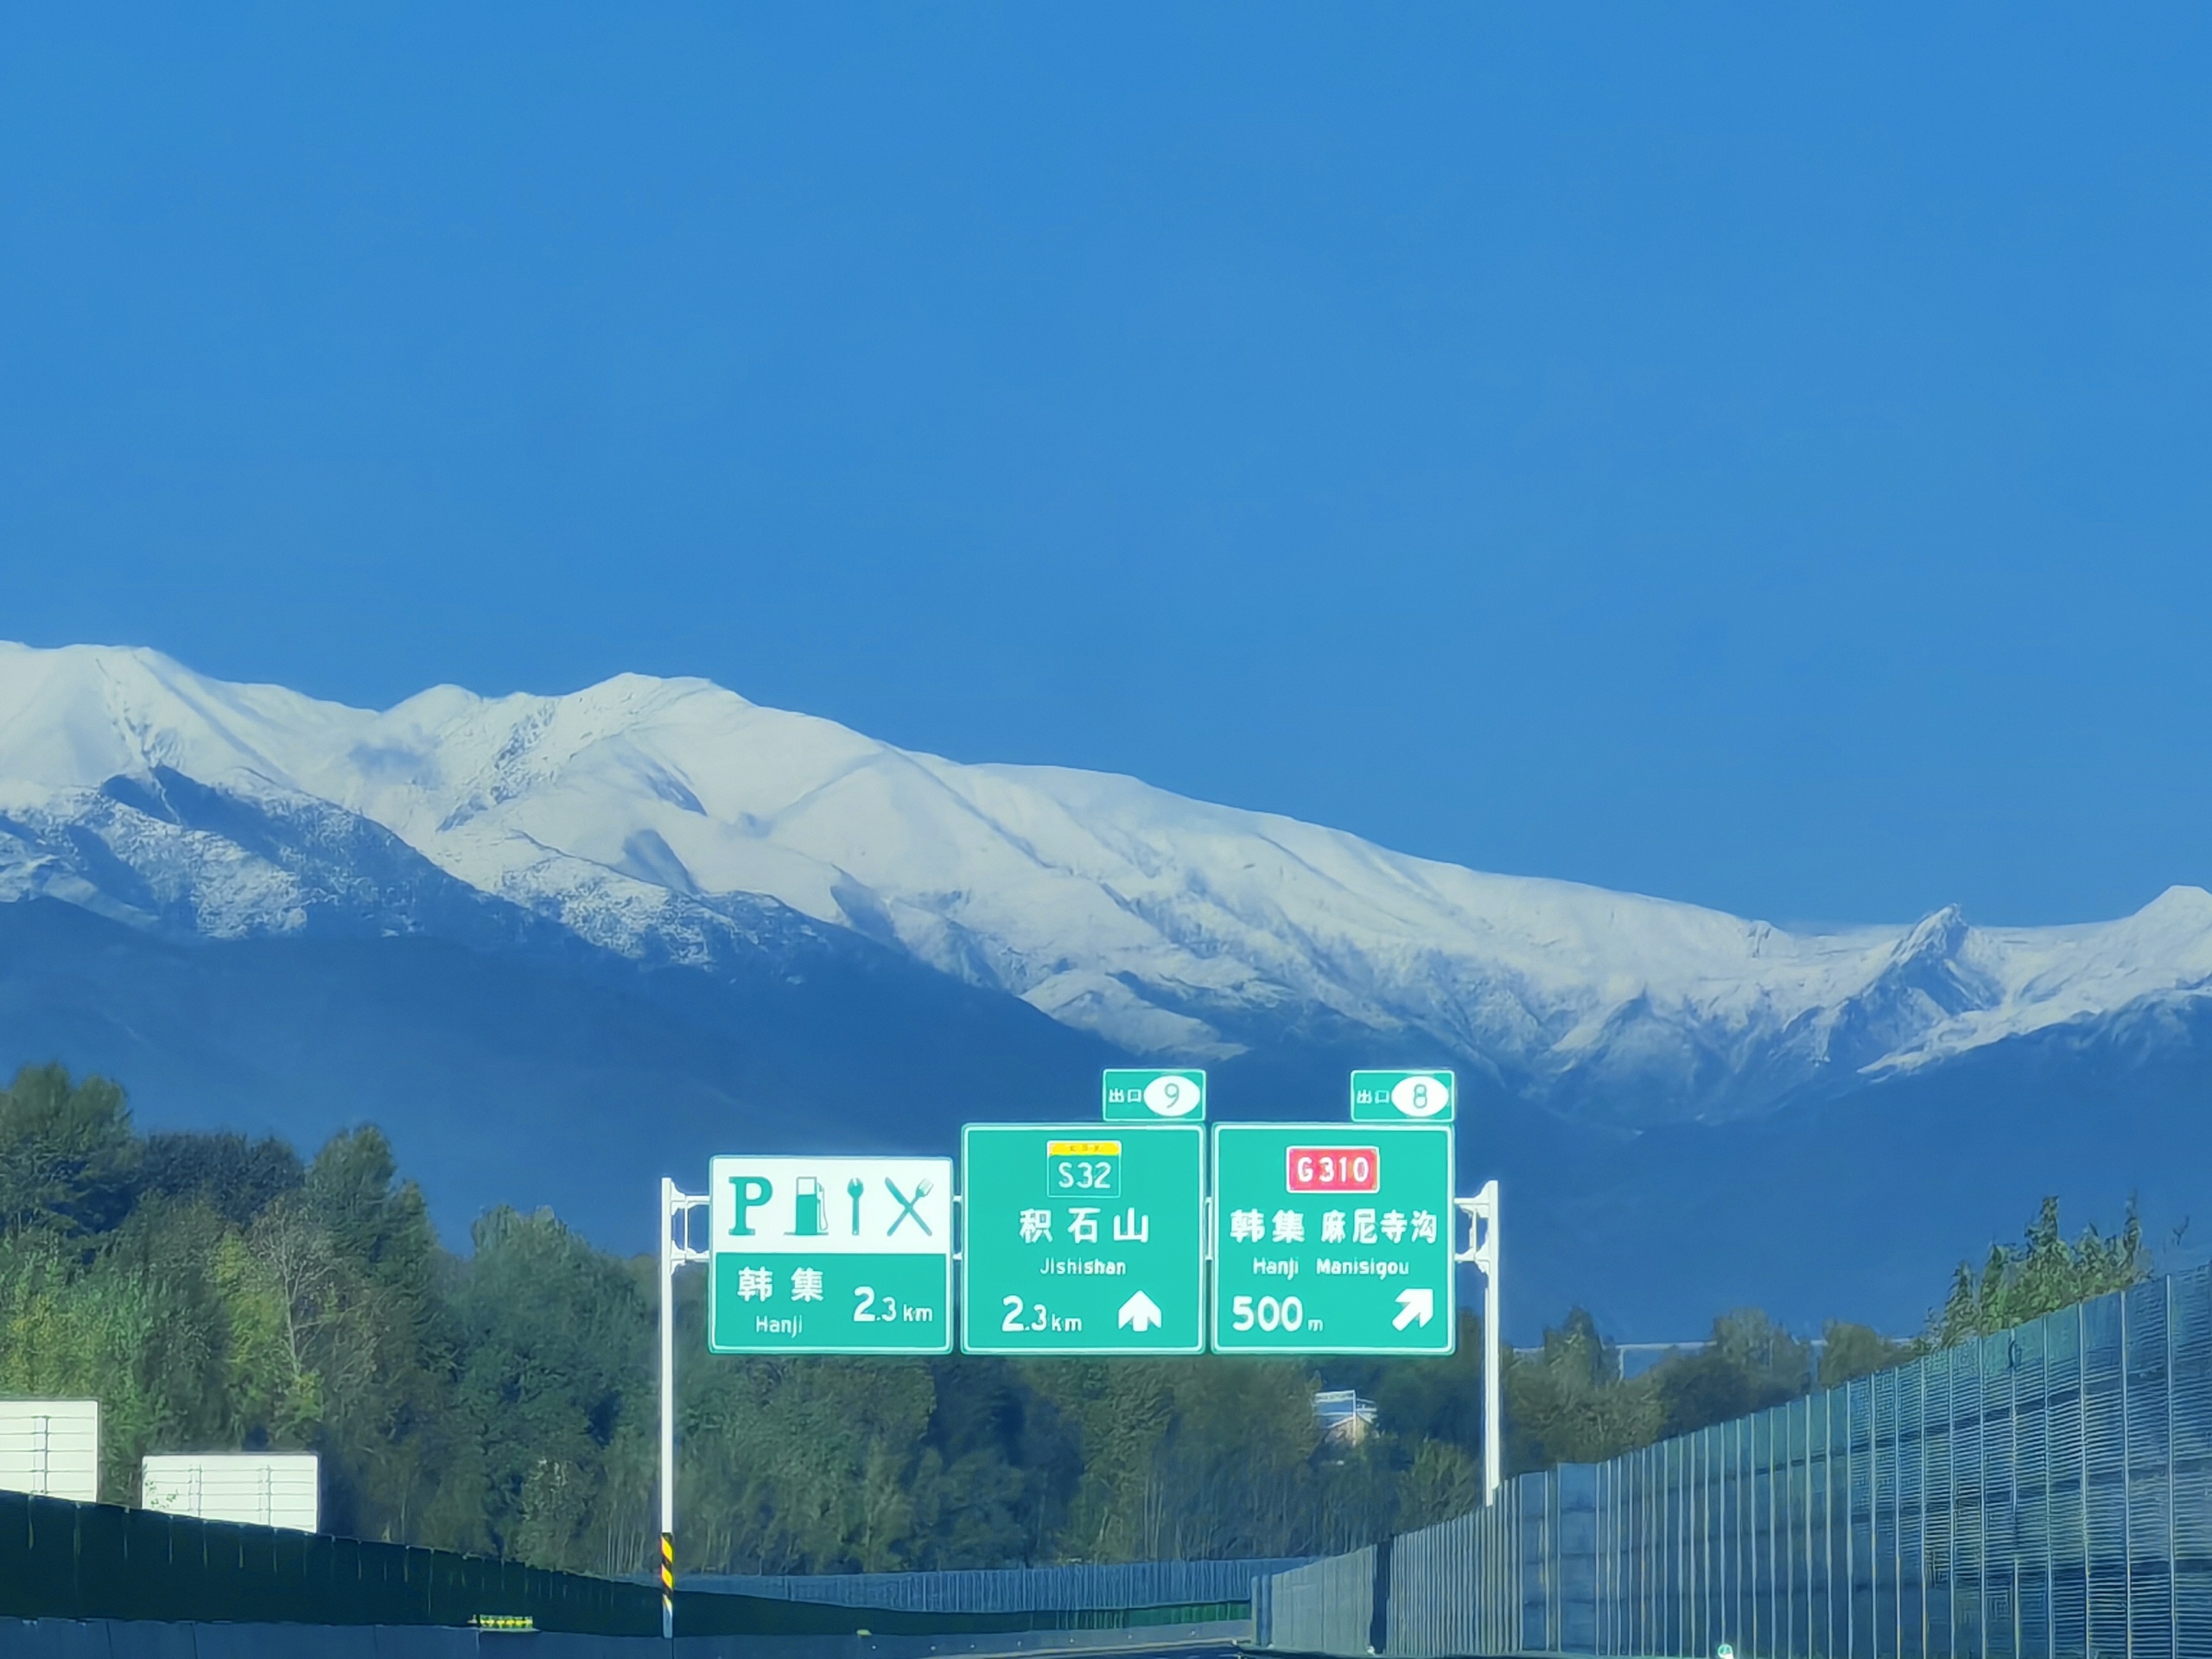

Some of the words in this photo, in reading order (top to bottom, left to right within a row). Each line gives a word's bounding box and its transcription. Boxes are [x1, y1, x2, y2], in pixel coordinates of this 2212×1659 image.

[1109, 1088, 1141, 1103] 出口
[1164, 1083, 1180, 1109] 9
[1357, 1089, 1389, 1104] 出口
[1413, 1084, 1428, 1109] 8
[1058, 1162, 1111, 1188] S32
[1297, 1156, 1370, 1183] G310
[1019, 1207, 1149, 1243] 积石山
[1230, 1208, 1305, 1243] 韩集
[1321, 1208, 1437, 1243] 麻尼寺沟
[1039, 1257, 1126, 1275] Jishishan
[1253, 1257, 1299, 1281] Hanji
[1316, 1257, 1409, 1281] Manisigou
[737, 1266, 823, 1302] 韩集
[755, 1315, 803, 1338] Hanji
